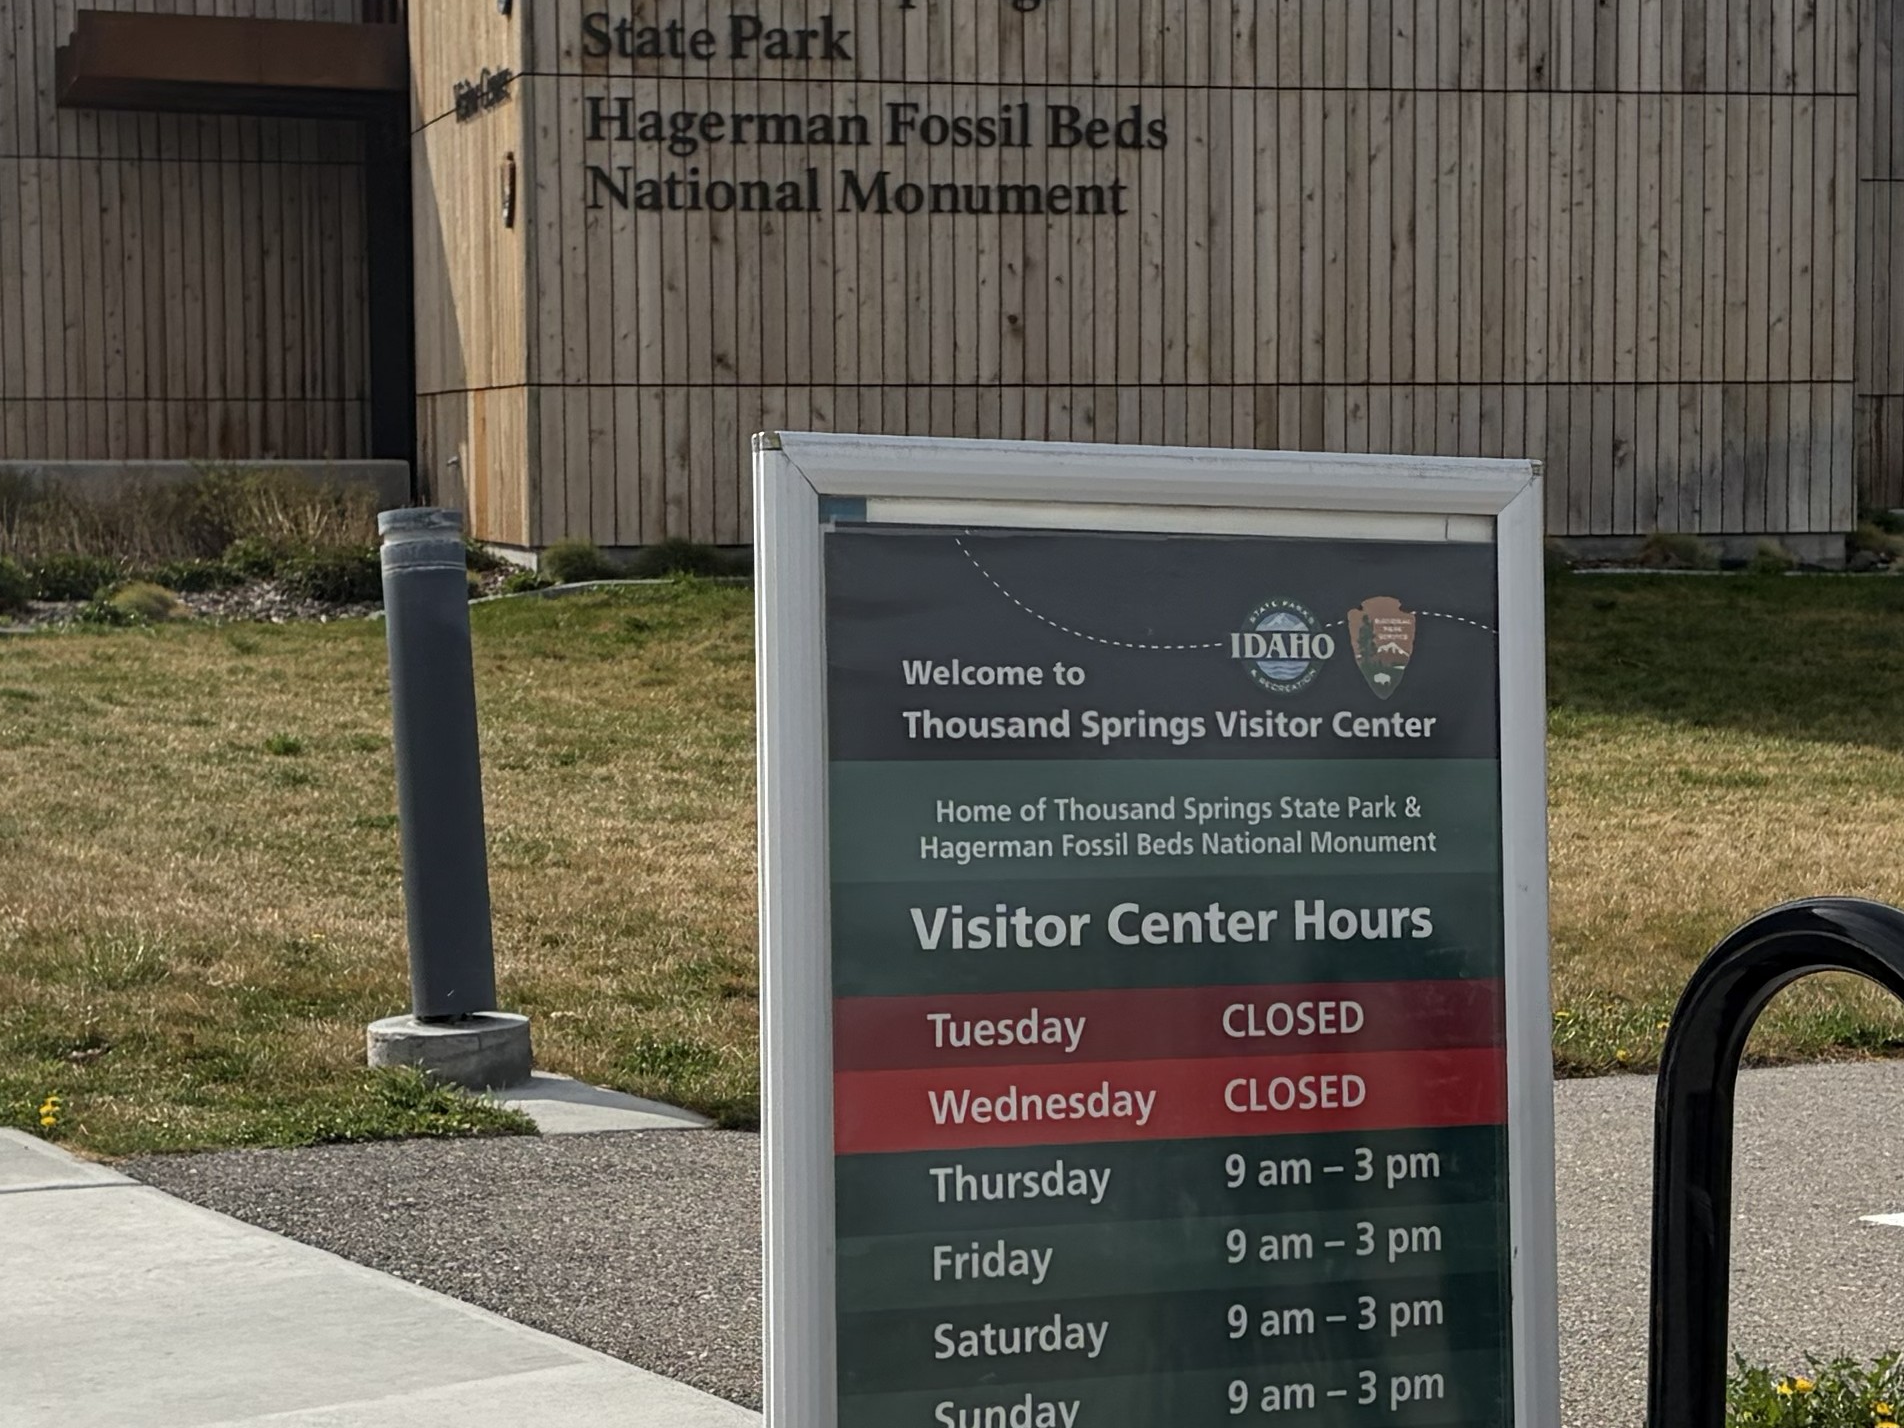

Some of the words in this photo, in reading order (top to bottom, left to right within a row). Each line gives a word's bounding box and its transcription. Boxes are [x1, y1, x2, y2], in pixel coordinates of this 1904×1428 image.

[579, 13, 717, 61] State
[729, 16, 855, 62] Park
[585, 97, 871, 157] Hagerman
[885, 100, 1034, 148] Fossil
[1046, 104, 1169, 151] Beds
[584, 166, 823, 214] National
[837, 170, 1130, 217] Monument
[1230, 632, 1335, 660] IDAHO
[902, 658, 1044, 686] Welcome
[1052, 661, 1086, 686] to
[902, 708, 1071, 739] Thousand
[1081, 709, 1206, 746] Springs
[1215, 709, 1323, 738] Visitor
[1332, 710, 1437, 738] Center
[936, 799, 1012, 823] Home
[1019, 796, 1047, 822] of
[1053, 795, 1176, 822] Thousand
[1183, 795, 1273, 826] Springs
[1280, 796, 1341, 819] State
[1347, 794, 1397, 819] Park
[1404, 795, 1422, 818] &
[920, 836, 1053, 865] Hagerman
[1062, 831, 1128, 857] Fossil
[1137, 831, 1194, 856] Beds
[1202, 830, 1302, 855] National
[1310, 831, 1437, 853] Monument
[909, 903, 1091, 950] Visitor
[1107, 902, 1278, 945] Center
[1294, 899, 1433, 941] Hours
[926, 1007, 1086, 1053] Tuesday
[1222, 1000, 1364, 1038] CLOSED
[927, 1080, 1157, 1126] Wednesday
[1224, 1074, 1366, 1113] CLOSED
[929, 1159, 1111, 1205] Thursday
[1225, 1153, 1246, 1188] 9
[1258, 1158, 1312, 1187] am
[1354, 1147, 1374, 1182] 3
[1386, 1152, 1440, 1189] pm
[933, 1239, 1053, 1285] Friday
[1226, 1228, 1247, 1264] 9
[1259, 1233, 1313, 1262] am
[1356, 1221, 1375, 1256] 3
[1388, 1225, 1442, 1263] pm
[934, 1313, 1109, 1359] Saturday
[1227, 1304, 1248, 1339] 9
[1260, 1307, 1315, 1337] am
[1358, 1295, 1377, 1330] 3
[1390, 1299, 1443, 1338] pm
[1228, 1379, 1249, 1415] 9
[1260, 1383, 1315, 1412] am
[1358, 1370, 1377, 1405] 3
[1390, 1373, 1444, 1411] pm
